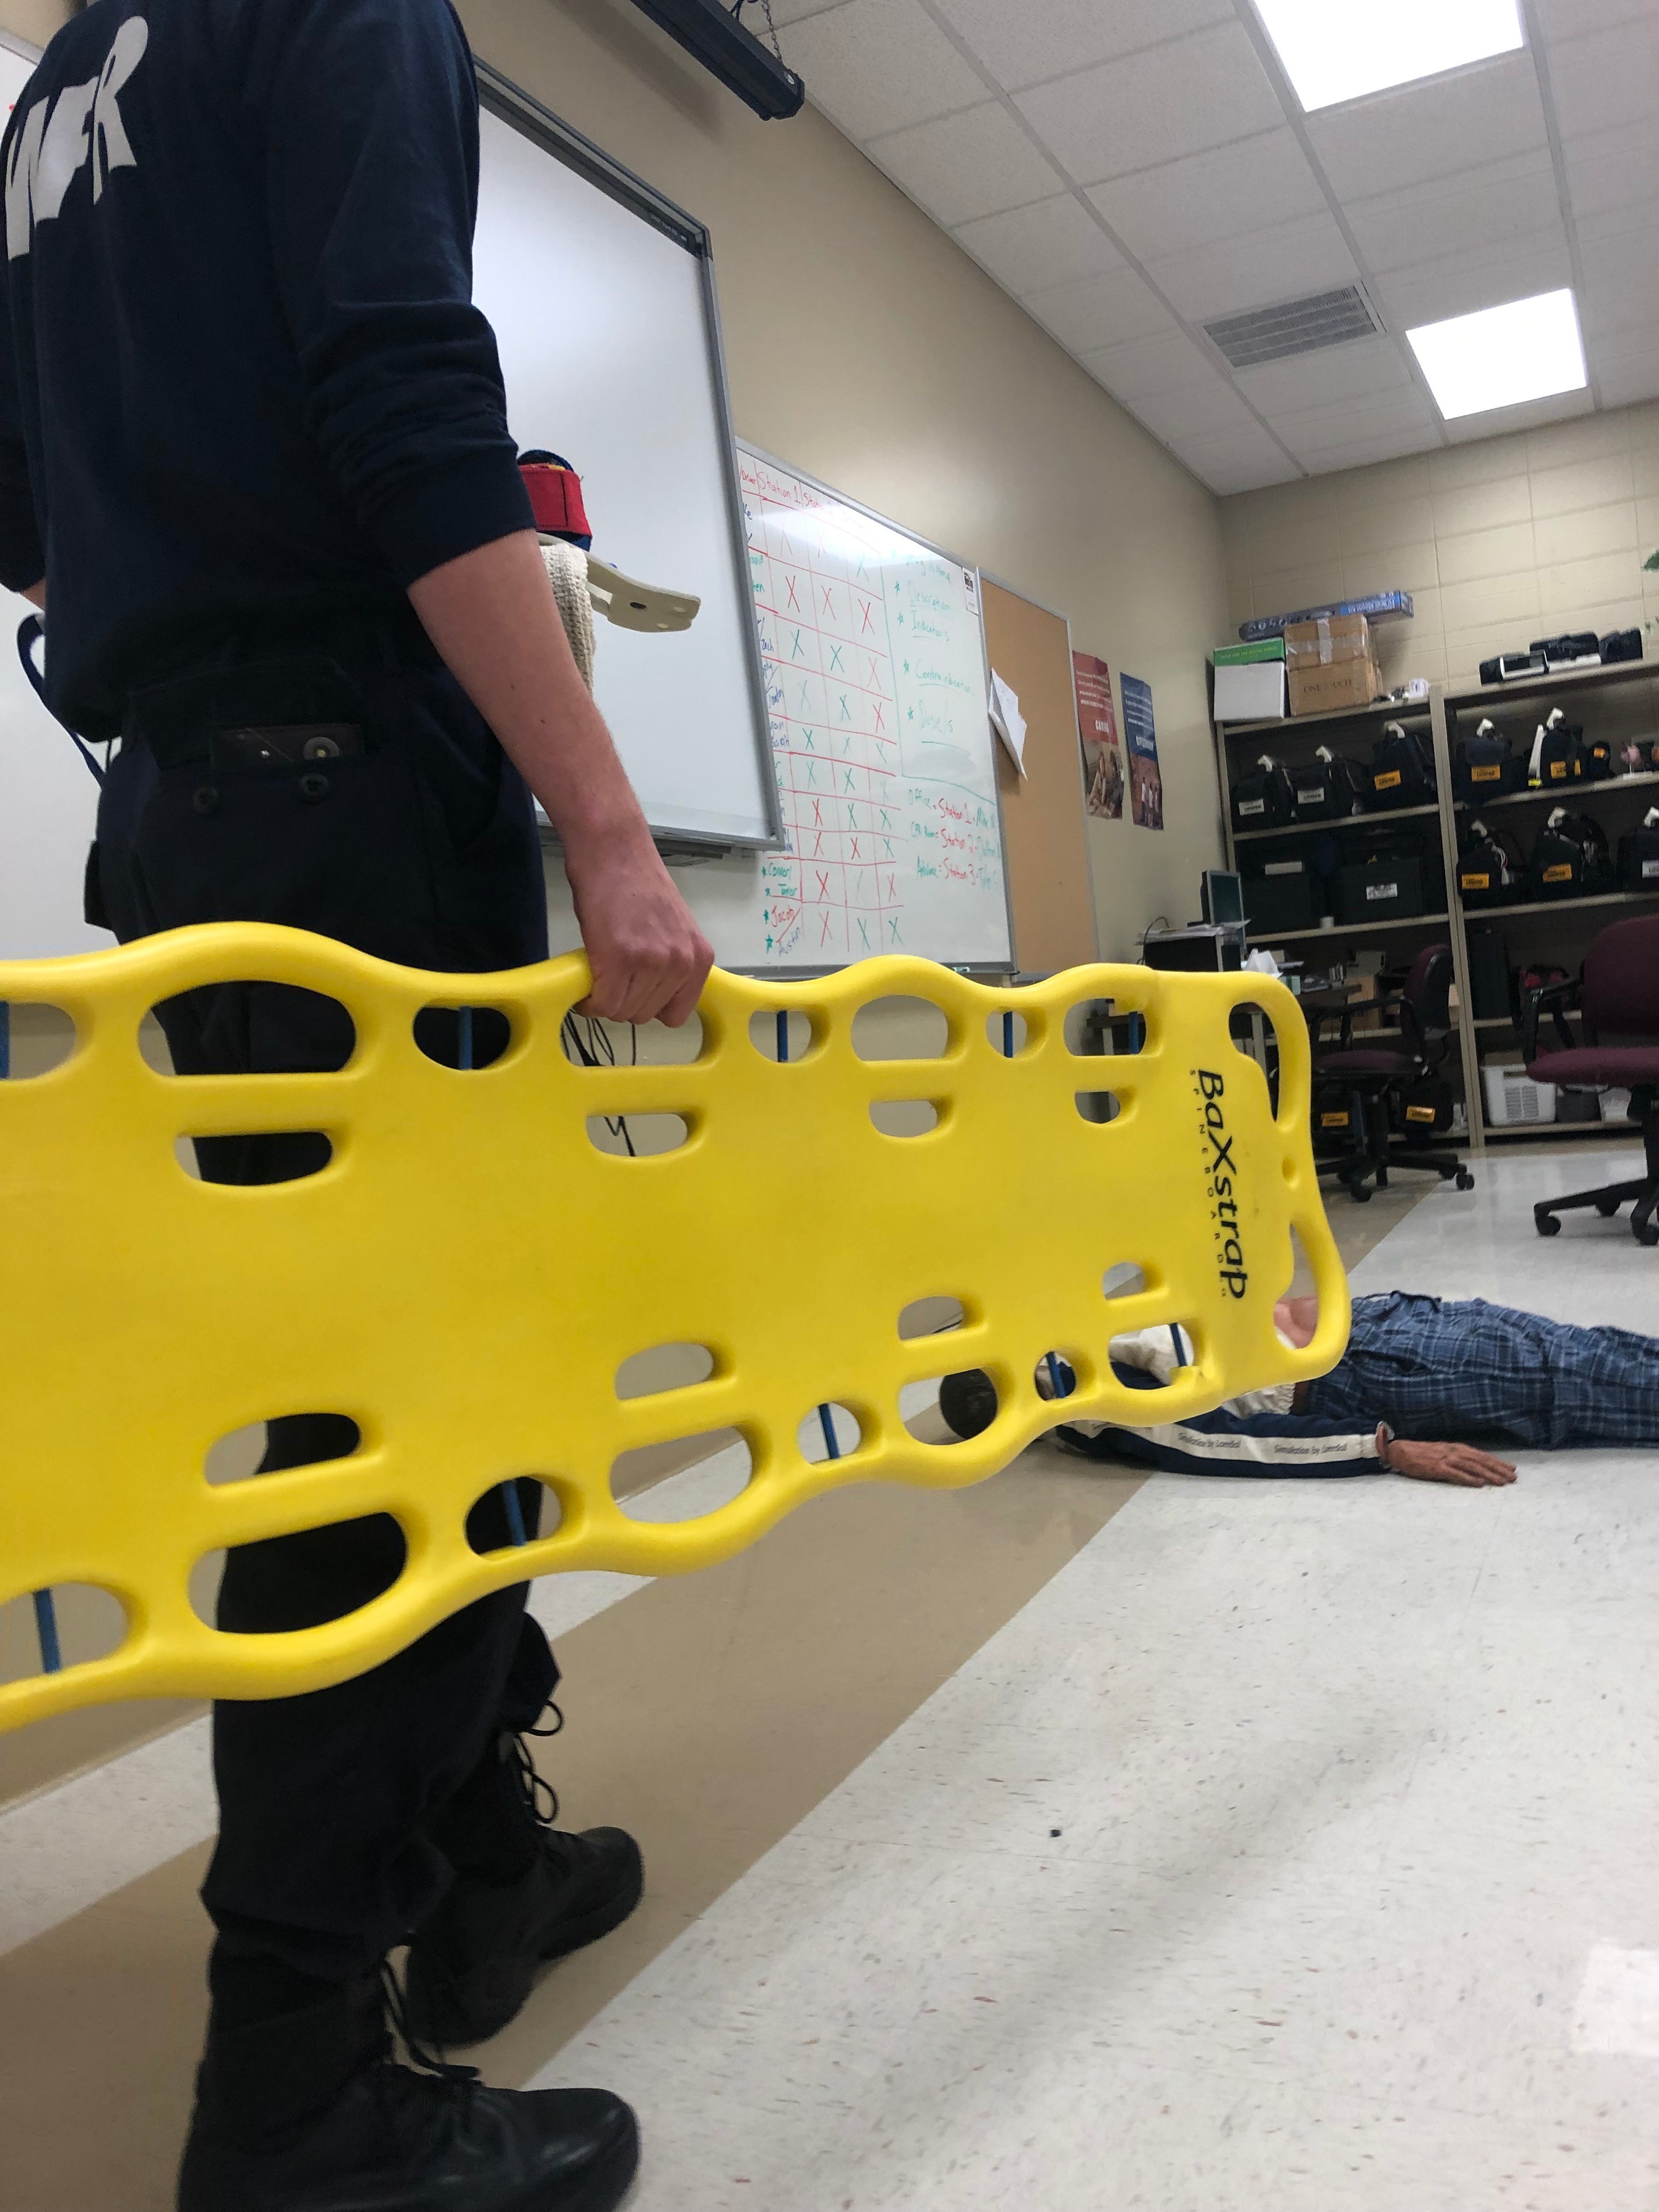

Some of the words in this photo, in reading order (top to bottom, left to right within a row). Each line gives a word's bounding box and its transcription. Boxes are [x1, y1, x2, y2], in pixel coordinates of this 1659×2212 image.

[758, 471, 791, 500] Station
[939, 798, 962, 820] Station
[941, 828, 966, 849] Station
[943, 857, 967, 879] Station
[1198, 1068, 1249, 1300] BaXstrap
[1274, 1443, 1310, 1455] Simulation
[1311, 1446, 1320, 1456] by
